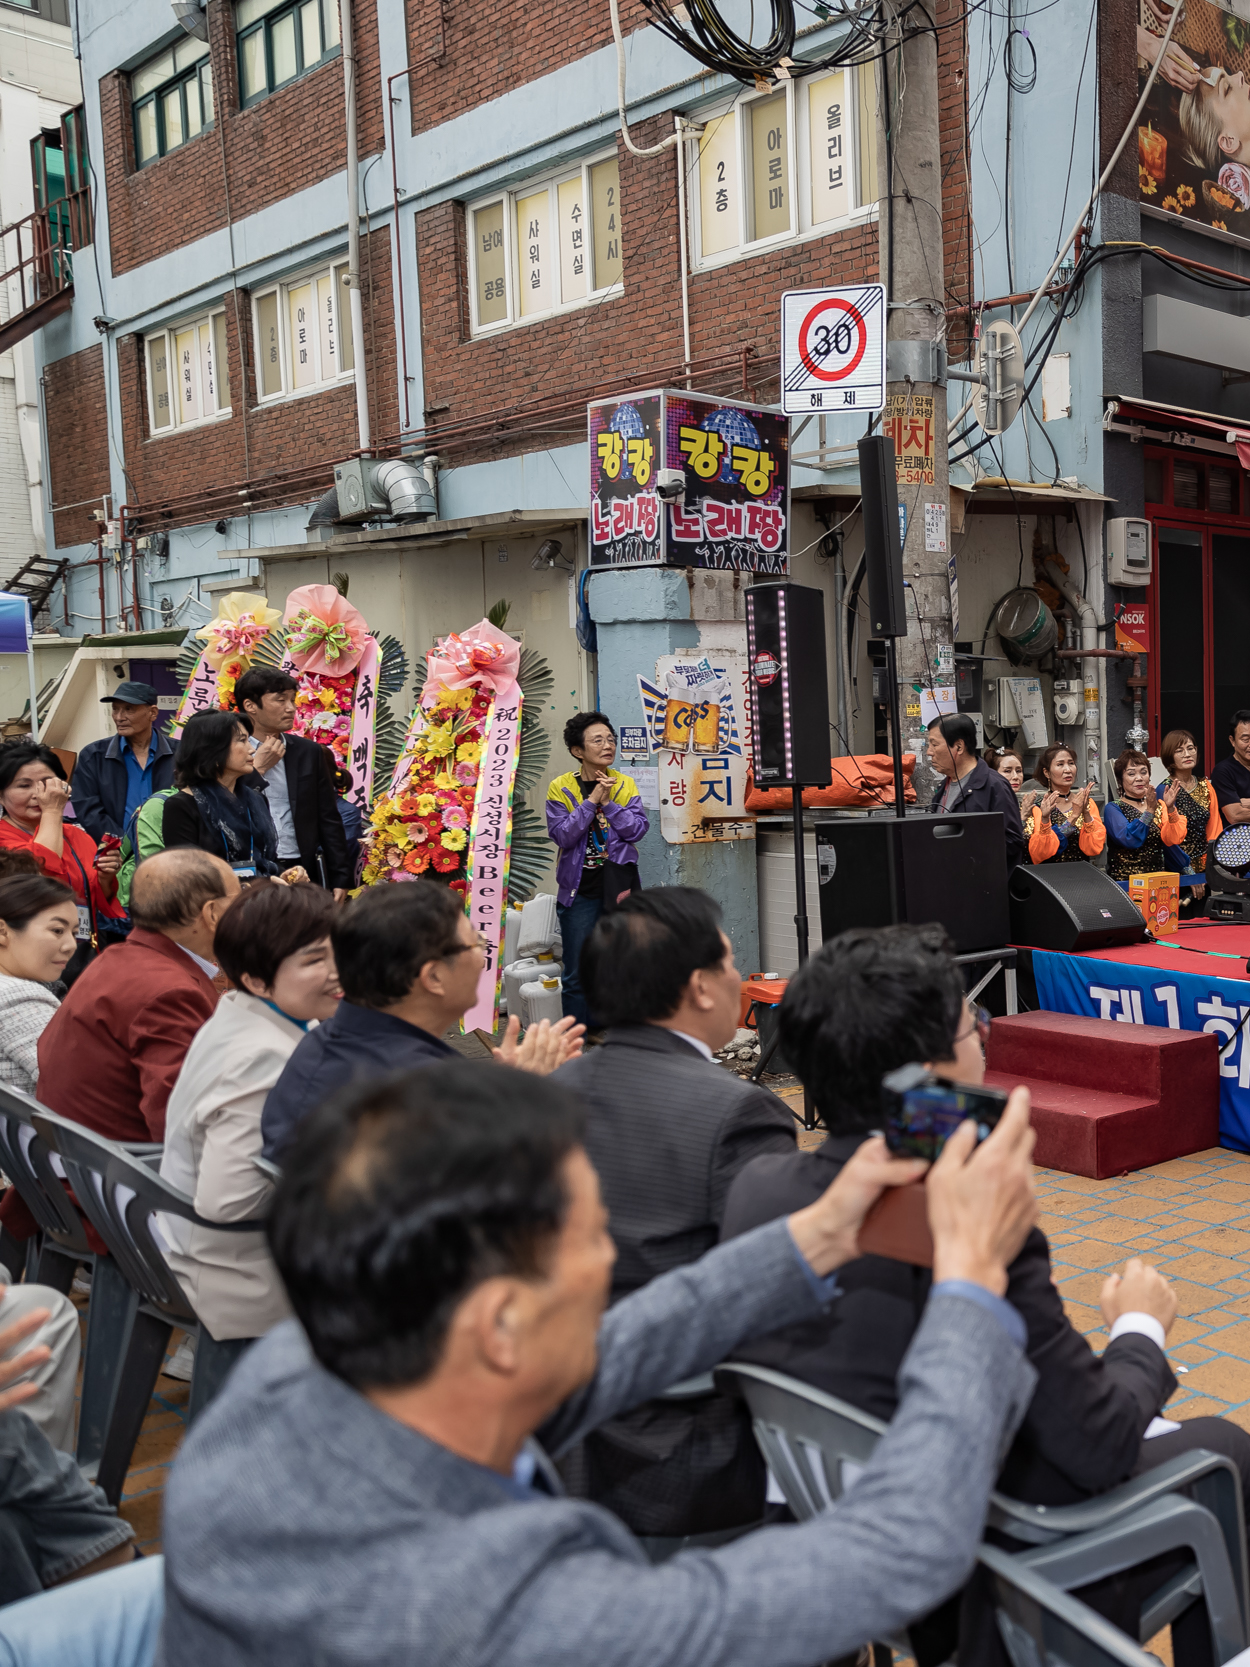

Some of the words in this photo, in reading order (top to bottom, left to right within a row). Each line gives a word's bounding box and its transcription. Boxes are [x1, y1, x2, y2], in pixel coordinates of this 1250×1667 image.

[767, 127, 784, 210] 아로마
[827, 103, 843, 190] 올리브
[716, 160, 729, 213] 2층
[482, 228, 503, 253] 남여
[570, 203, 585, 276] 수면실
[606, 186, 619, 261] 24시
[528, 218, 541, 290] 샤워실
[484, 277, 505, 301] 공용
[297, 306, 308, 365] 아로마
[813, 323, 852, 356] 30
[597, 431, 654, 487] 캉캉
[679, 425, 776, 497] 캉캉
[1119, 613, 1146, 625] NSOK
[356, 673, 375, 721] 축
[494, 705, 519, 724] 祝
[488, 726, 512, 790] 2023
[621, 736, 647, 749] 주차금지
[477, 794, 506, 861] 신성시장
[476, 864, 501, 933] Beer
